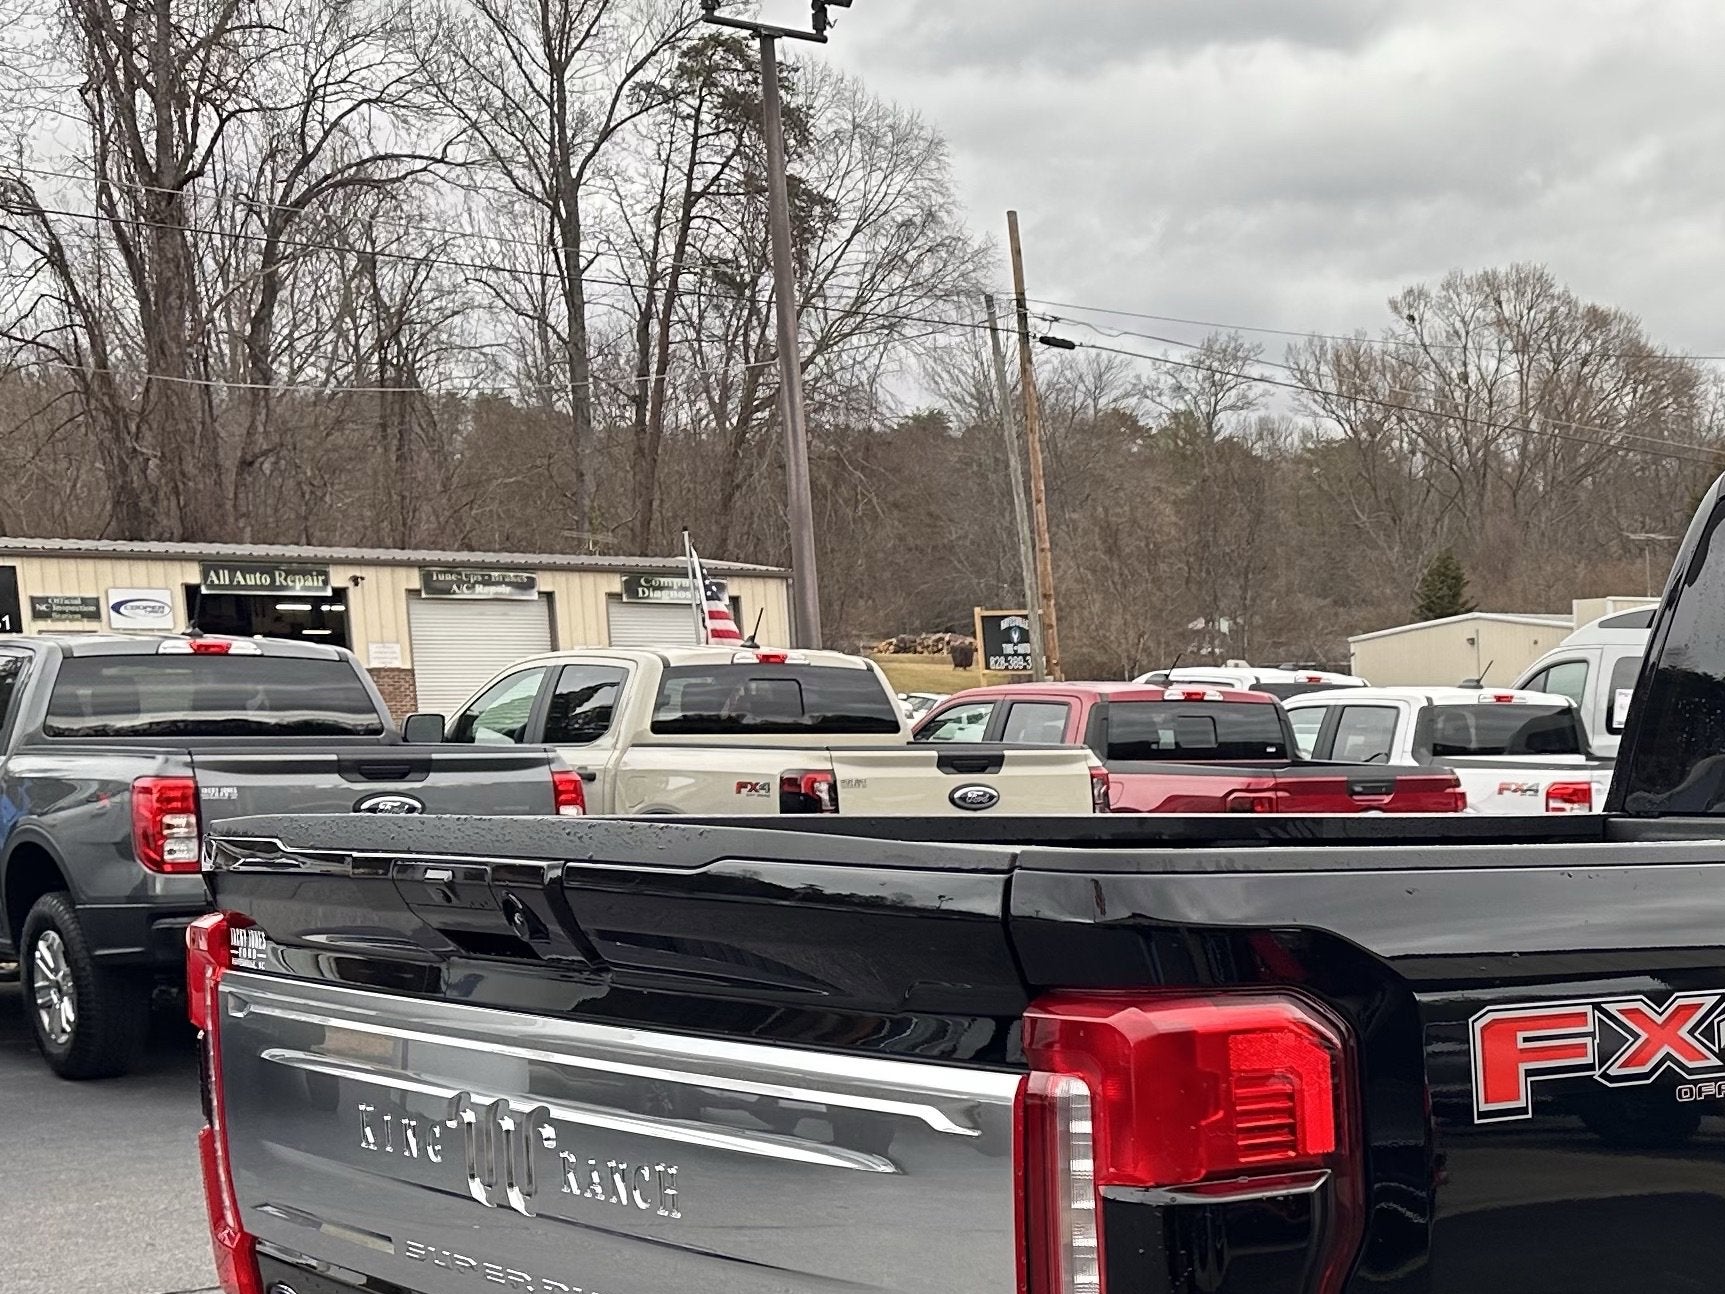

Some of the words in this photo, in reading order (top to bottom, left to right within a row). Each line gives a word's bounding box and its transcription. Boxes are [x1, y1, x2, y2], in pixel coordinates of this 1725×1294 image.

[206, 569, 230, 585] All
[232, 570, 271, 586] Auto
[273, 570, 326, 591] Repair
[735, 781, 770, 794] FX4
[358, 1103, 443, 1164] KING
[559, 1150, 682, 1219] RANCH
[405, 1240, 536, 1293] SUPER
